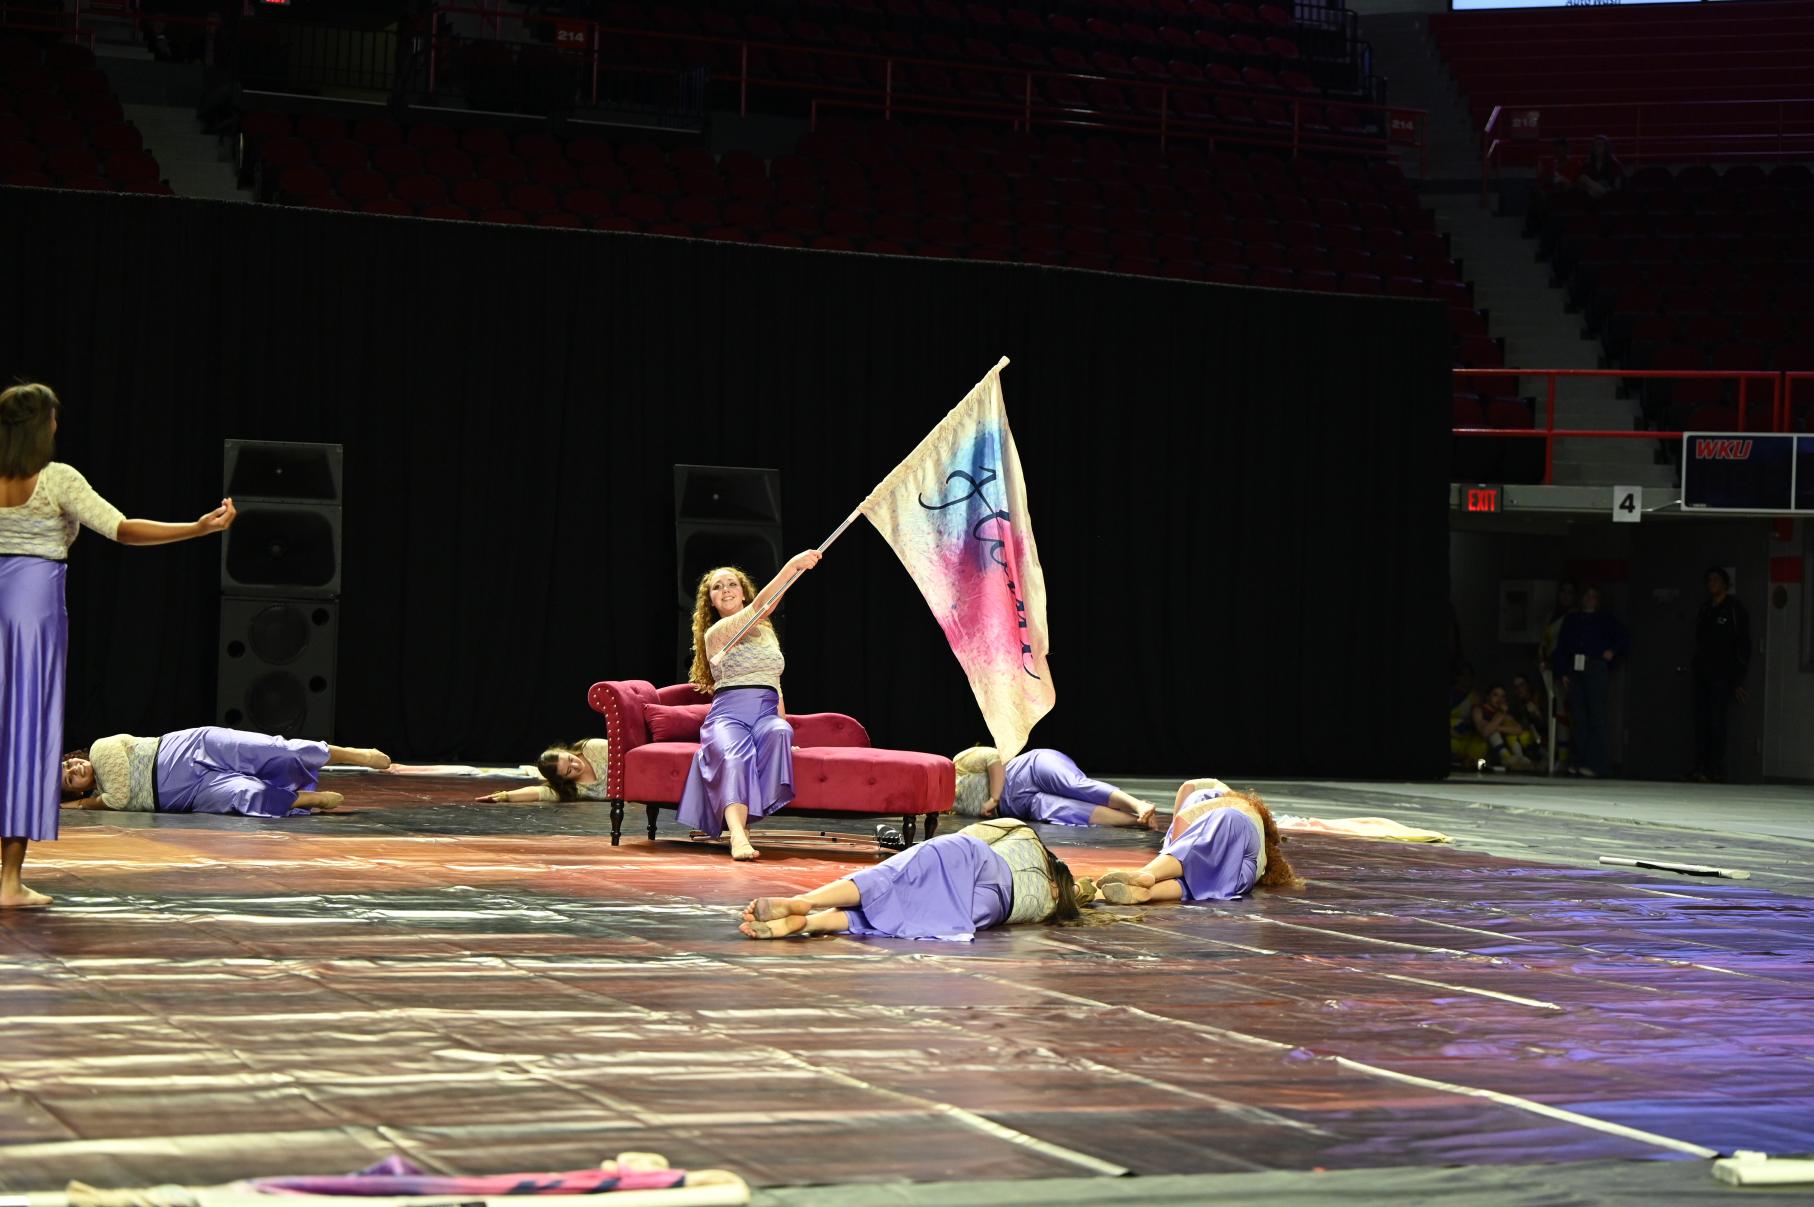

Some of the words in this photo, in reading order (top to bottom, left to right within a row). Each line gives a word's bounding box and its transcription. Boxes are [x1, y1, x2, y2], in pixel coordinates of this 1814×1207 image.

[557, 29, 584, 42] 214
[1391, 119, 1414, 130] 214
[1696, 439, 1753, 460] WKU
[1468, 488, 1497, 512] EXIT
[1618, 492, 1636, 514] 4
